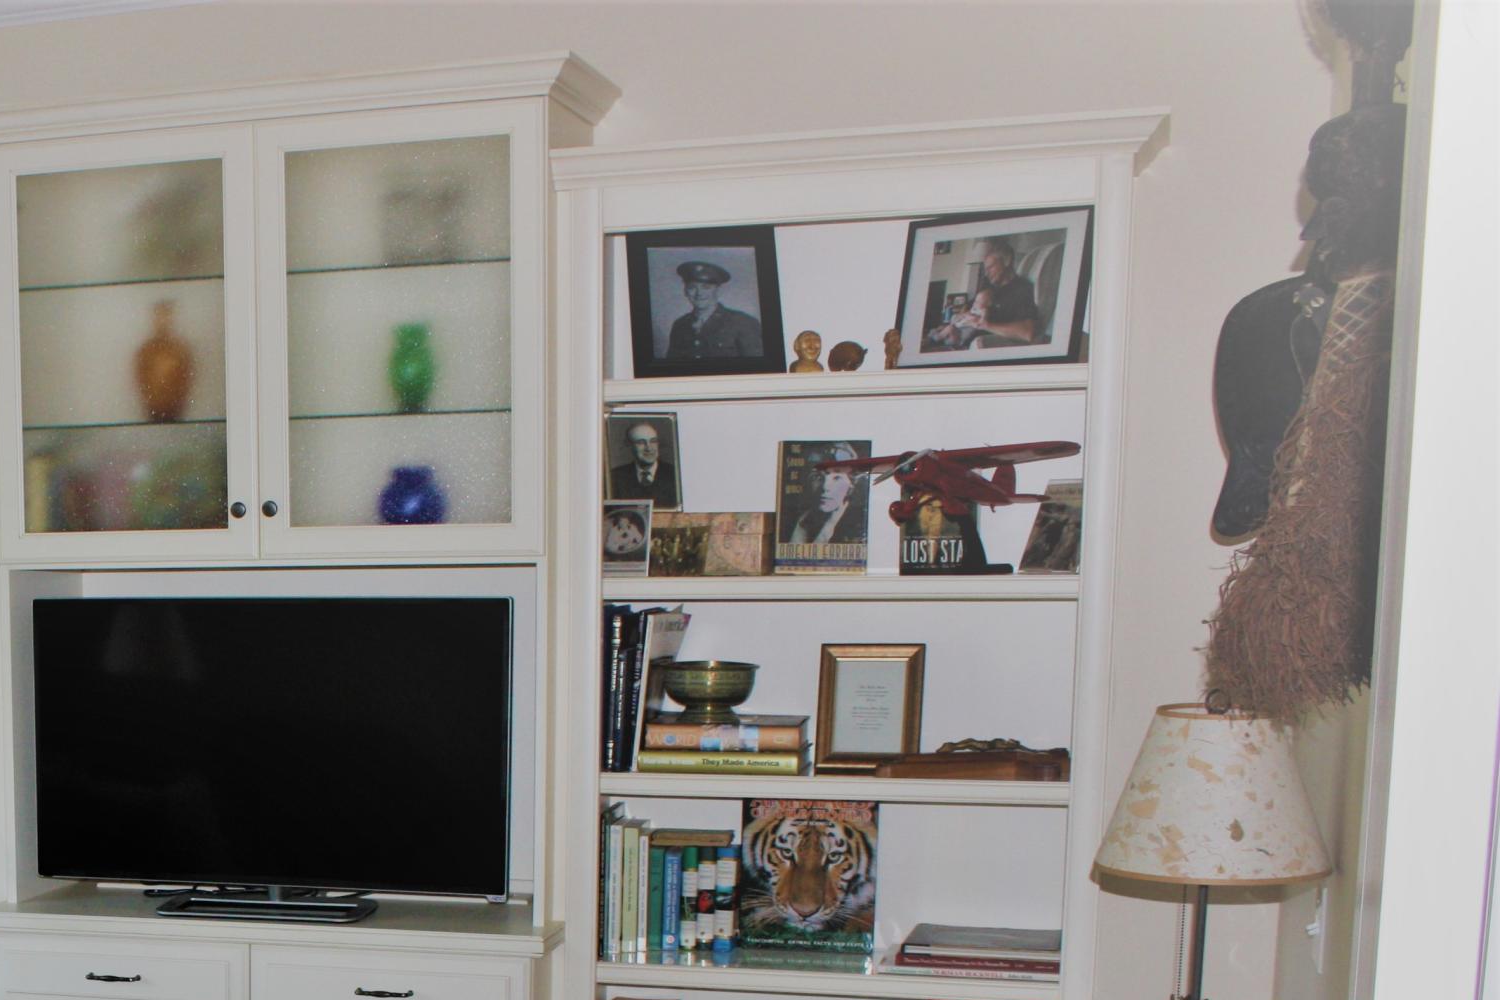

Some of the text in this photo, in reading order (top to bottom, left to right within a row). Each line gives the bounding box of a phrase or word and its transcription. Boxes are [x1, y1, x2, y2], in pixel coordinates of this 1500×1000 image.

[903, 539, 964, 563] LOST STA
[701, 758, 780, 767] They Made America
